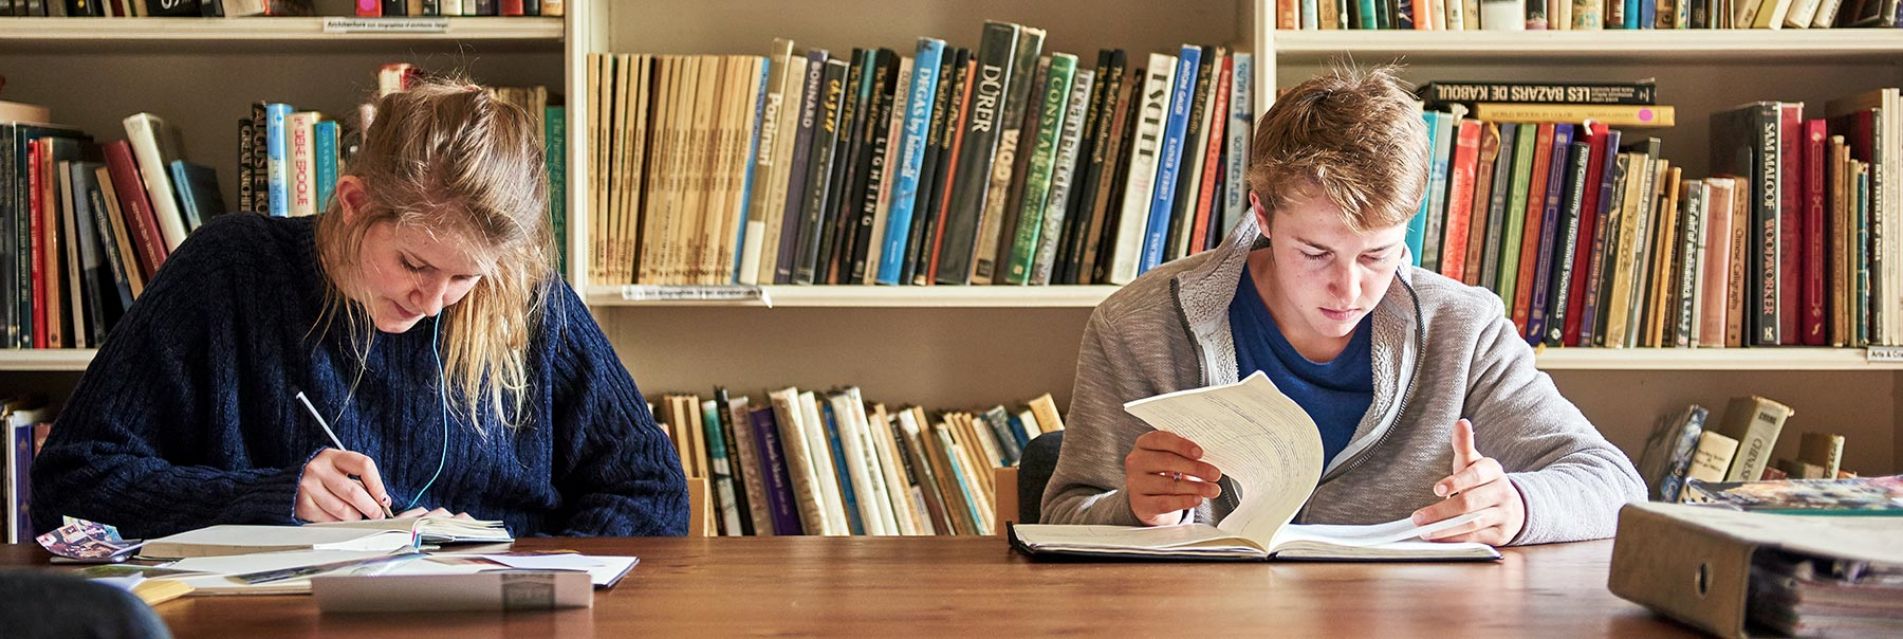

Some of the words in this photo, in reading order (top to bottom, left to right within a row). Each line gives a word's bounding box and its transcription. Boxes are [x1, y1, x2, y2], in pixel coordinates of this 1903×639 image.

[802, 60, 821, 128] BONNARD
[911, 66, 932, 116] DEGAS
[1179, 59, 1192, 90] ANTONI
[1437, 85, 1489, 100] KABOUL
[1492, 86, 1508, 100] DE
[1511, 86, 1564, 101] BAZARS
[1568, 86, 1590, 102] LES
[971, 63, 1003, 135] DÜRER
[757, 91, 781, 166] Portinari
[905, 116, 922, 132] by
[1031, 74, 1064, 183] CONSTABLE
[1764, 122, 1775, 150] SAM
[900, 134, 921, 179] himself
[993, 125, 1020, 182] GOYA
[1576, 146, 1588, 168] Andy
[861, 136, 886, 227] LIGHTING
[1569, 167, 1585, 215] Goldsworthy
[1764, 152, 1774, 210] MALOOF
[1734, 227, 1744, 261] Chinese
[1763, 217, 1774, 314] WOODWORKER
[1555, 271, 1569, 318] SNOWBALLS
[1729, 262, 1743, 310] Calligraphy
